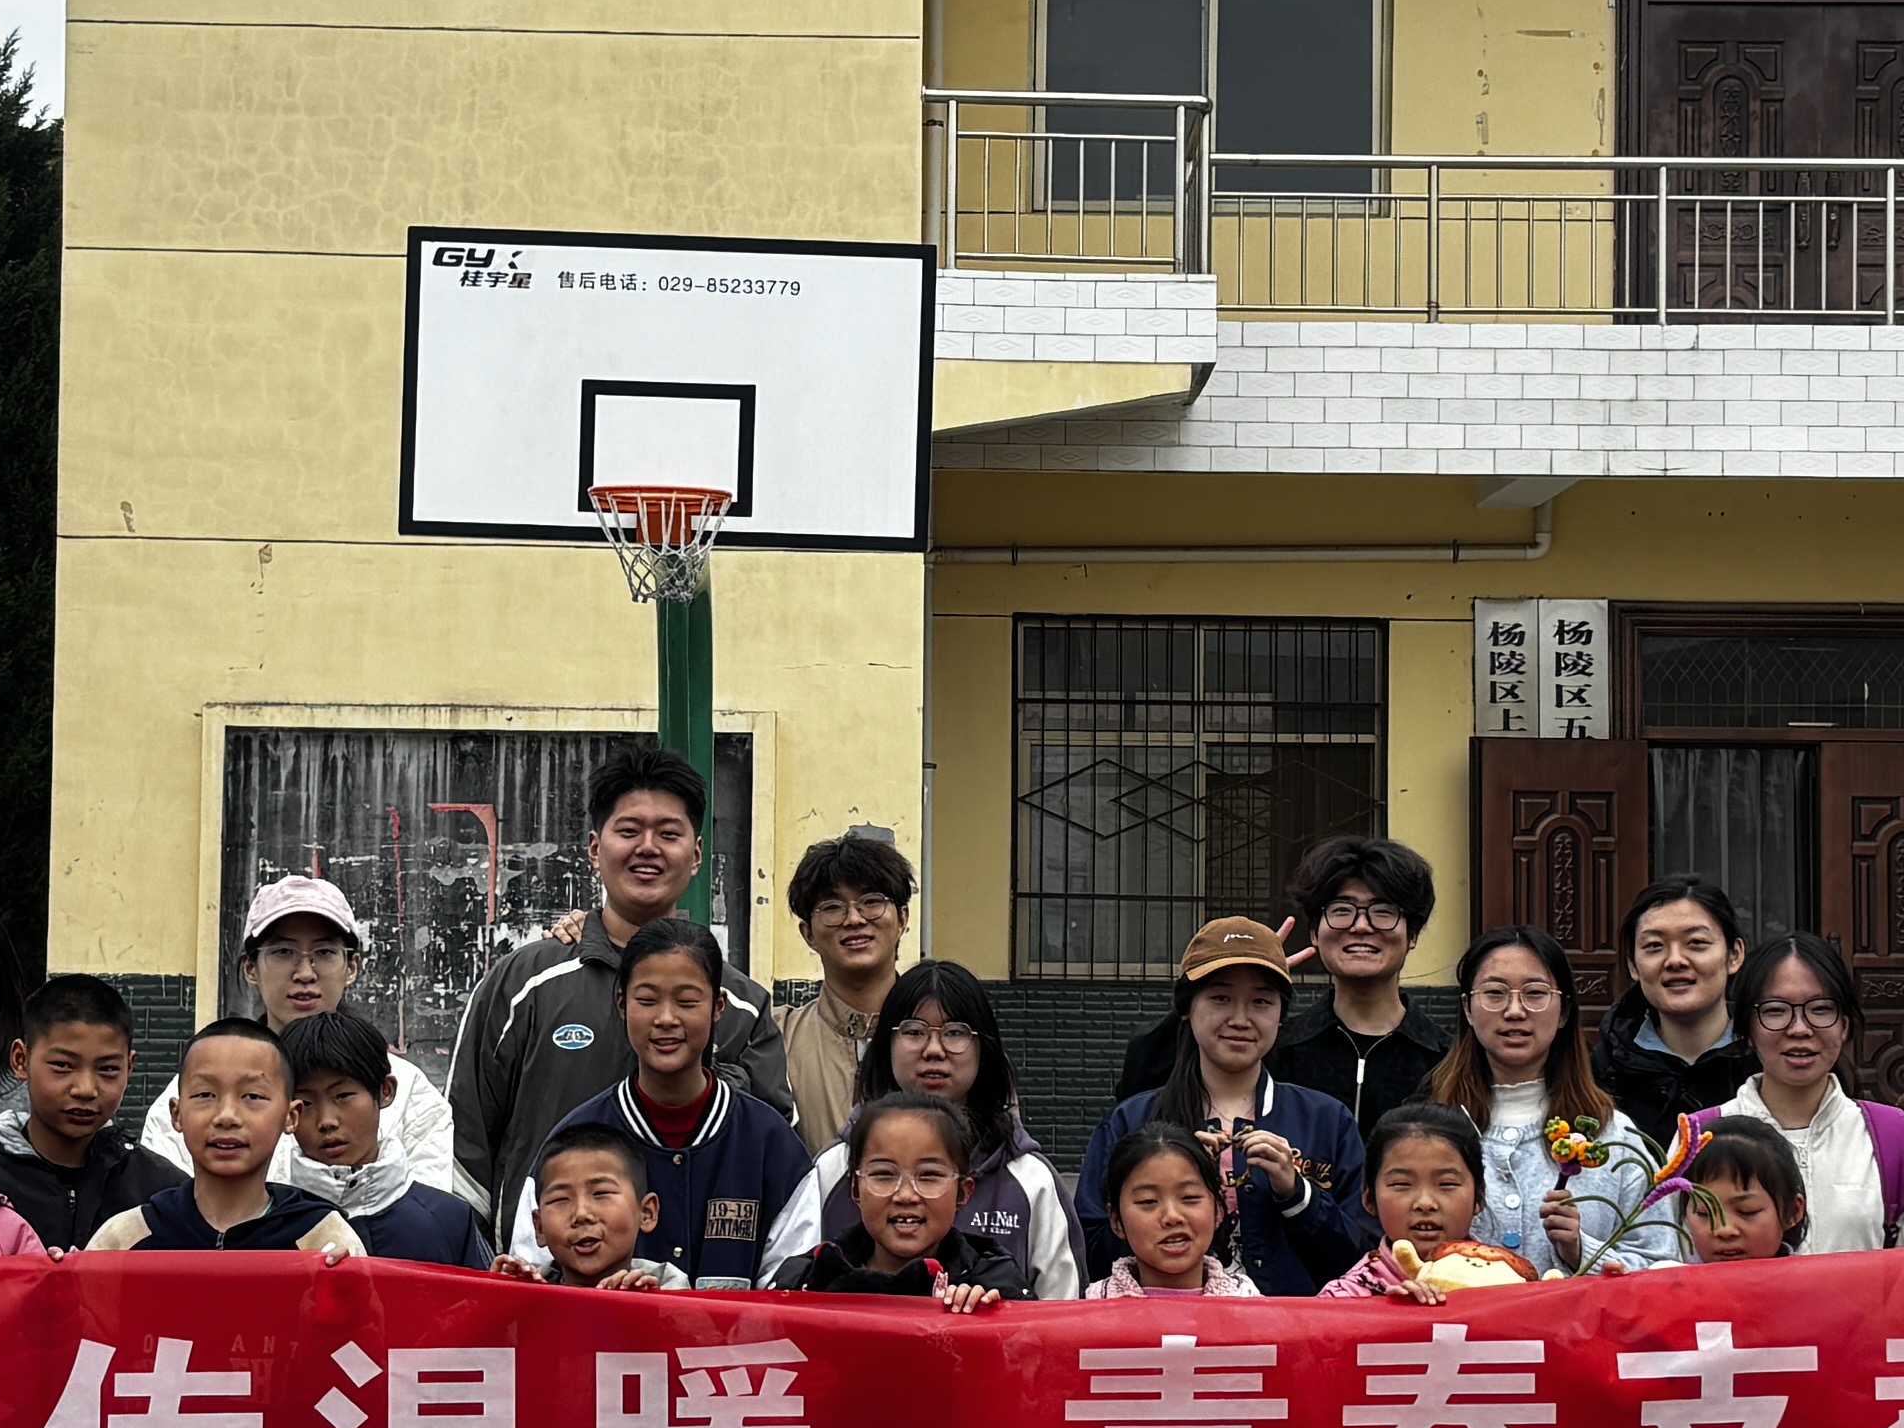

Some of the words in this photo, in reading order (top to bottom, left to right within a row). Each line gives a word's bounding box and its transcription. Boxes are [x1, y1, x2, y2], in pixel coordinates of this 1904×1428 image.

[658, 276, 801, 296] 029-85233779
[1487, 621, 1527, 732] 杨陵区上
[1553, 619, 1594, 739] 杨陵区五
[711, 1202, 754, 1219] 19-19
